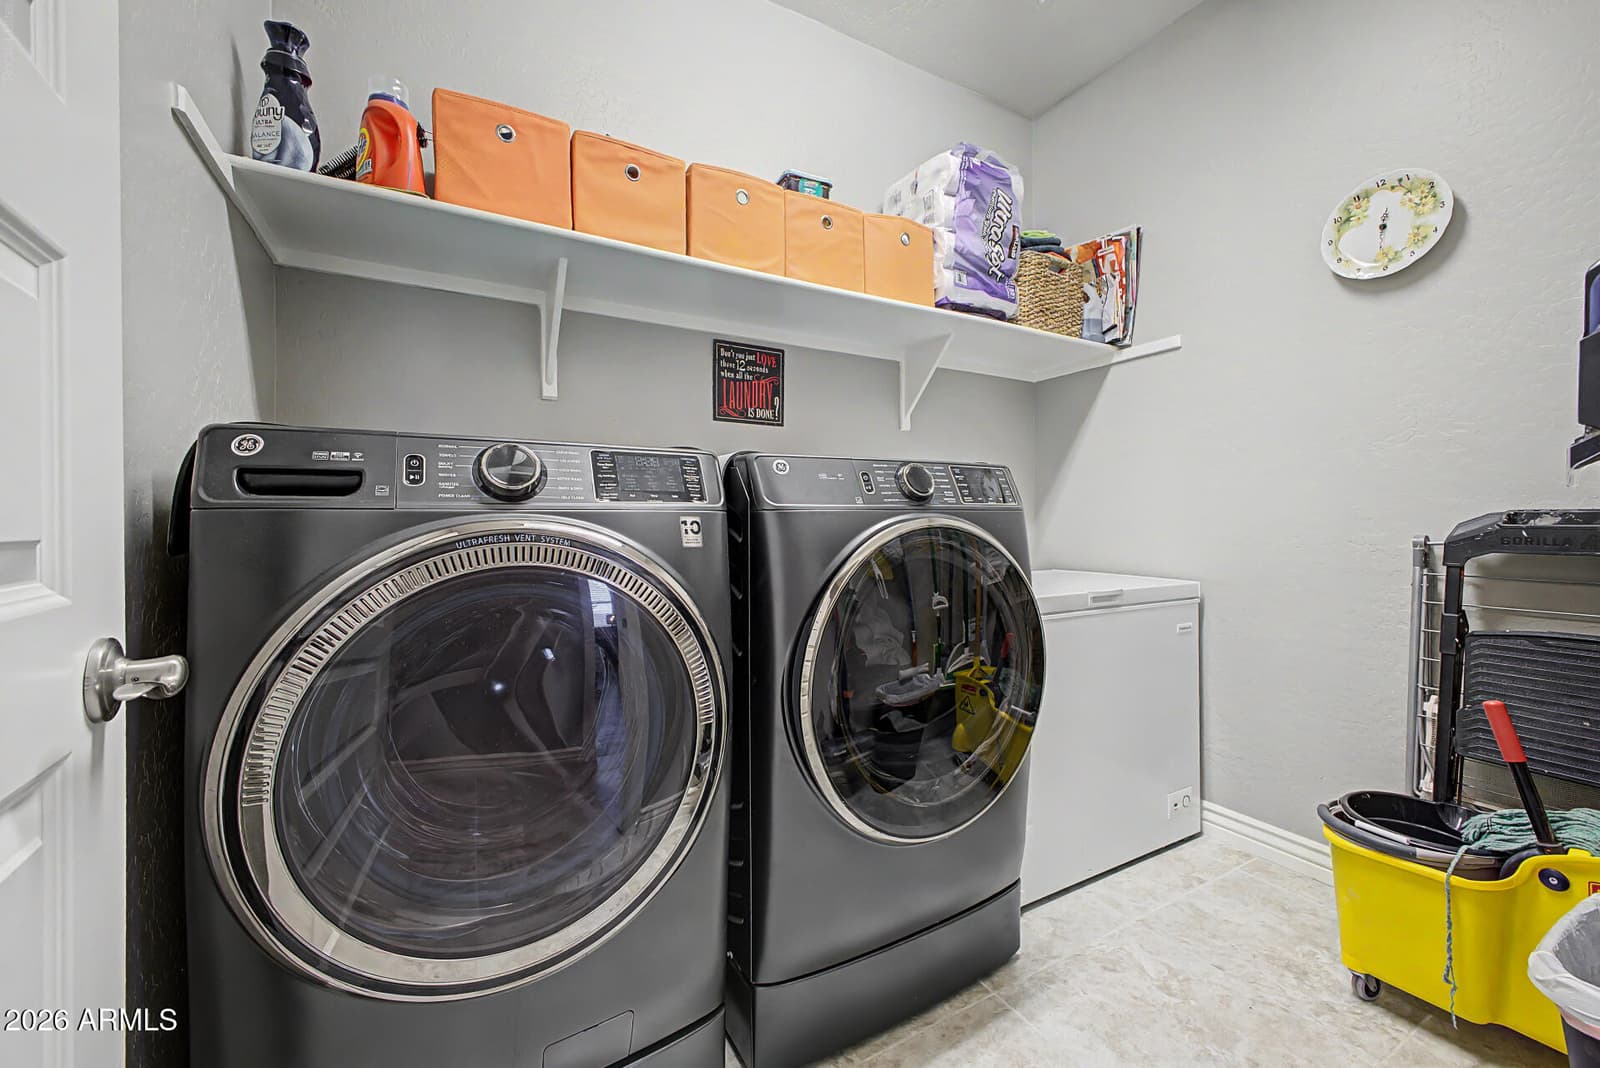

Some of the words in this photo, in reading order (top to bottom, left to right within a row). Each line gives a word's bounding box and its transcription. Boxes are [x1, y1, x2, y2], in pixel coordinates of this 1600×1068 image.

[1376, 179, 1387, 188] 12
[1333, 216, 1343, 225] 10
[720, 348, 734, 358] Don't
[745, 352, 756, 361] just
[756, 352, 777, 368] LOVE
[736, 360, 746, 371] 12
[747, 366, 768, 374] seconds
[720, 369, 734, 377] when
[744, 372, 753, 380] the
[721, 377, 775, 412] LAUNDRY
[748, 408, 755, 418] IS
[455, 534, 510, 549] ULTRAFRESH
[514, 533, 536, 542] VENT
[541, 536, 571, 546] SYSTEM
[1500, 536, 1571, 548] GORILLA
